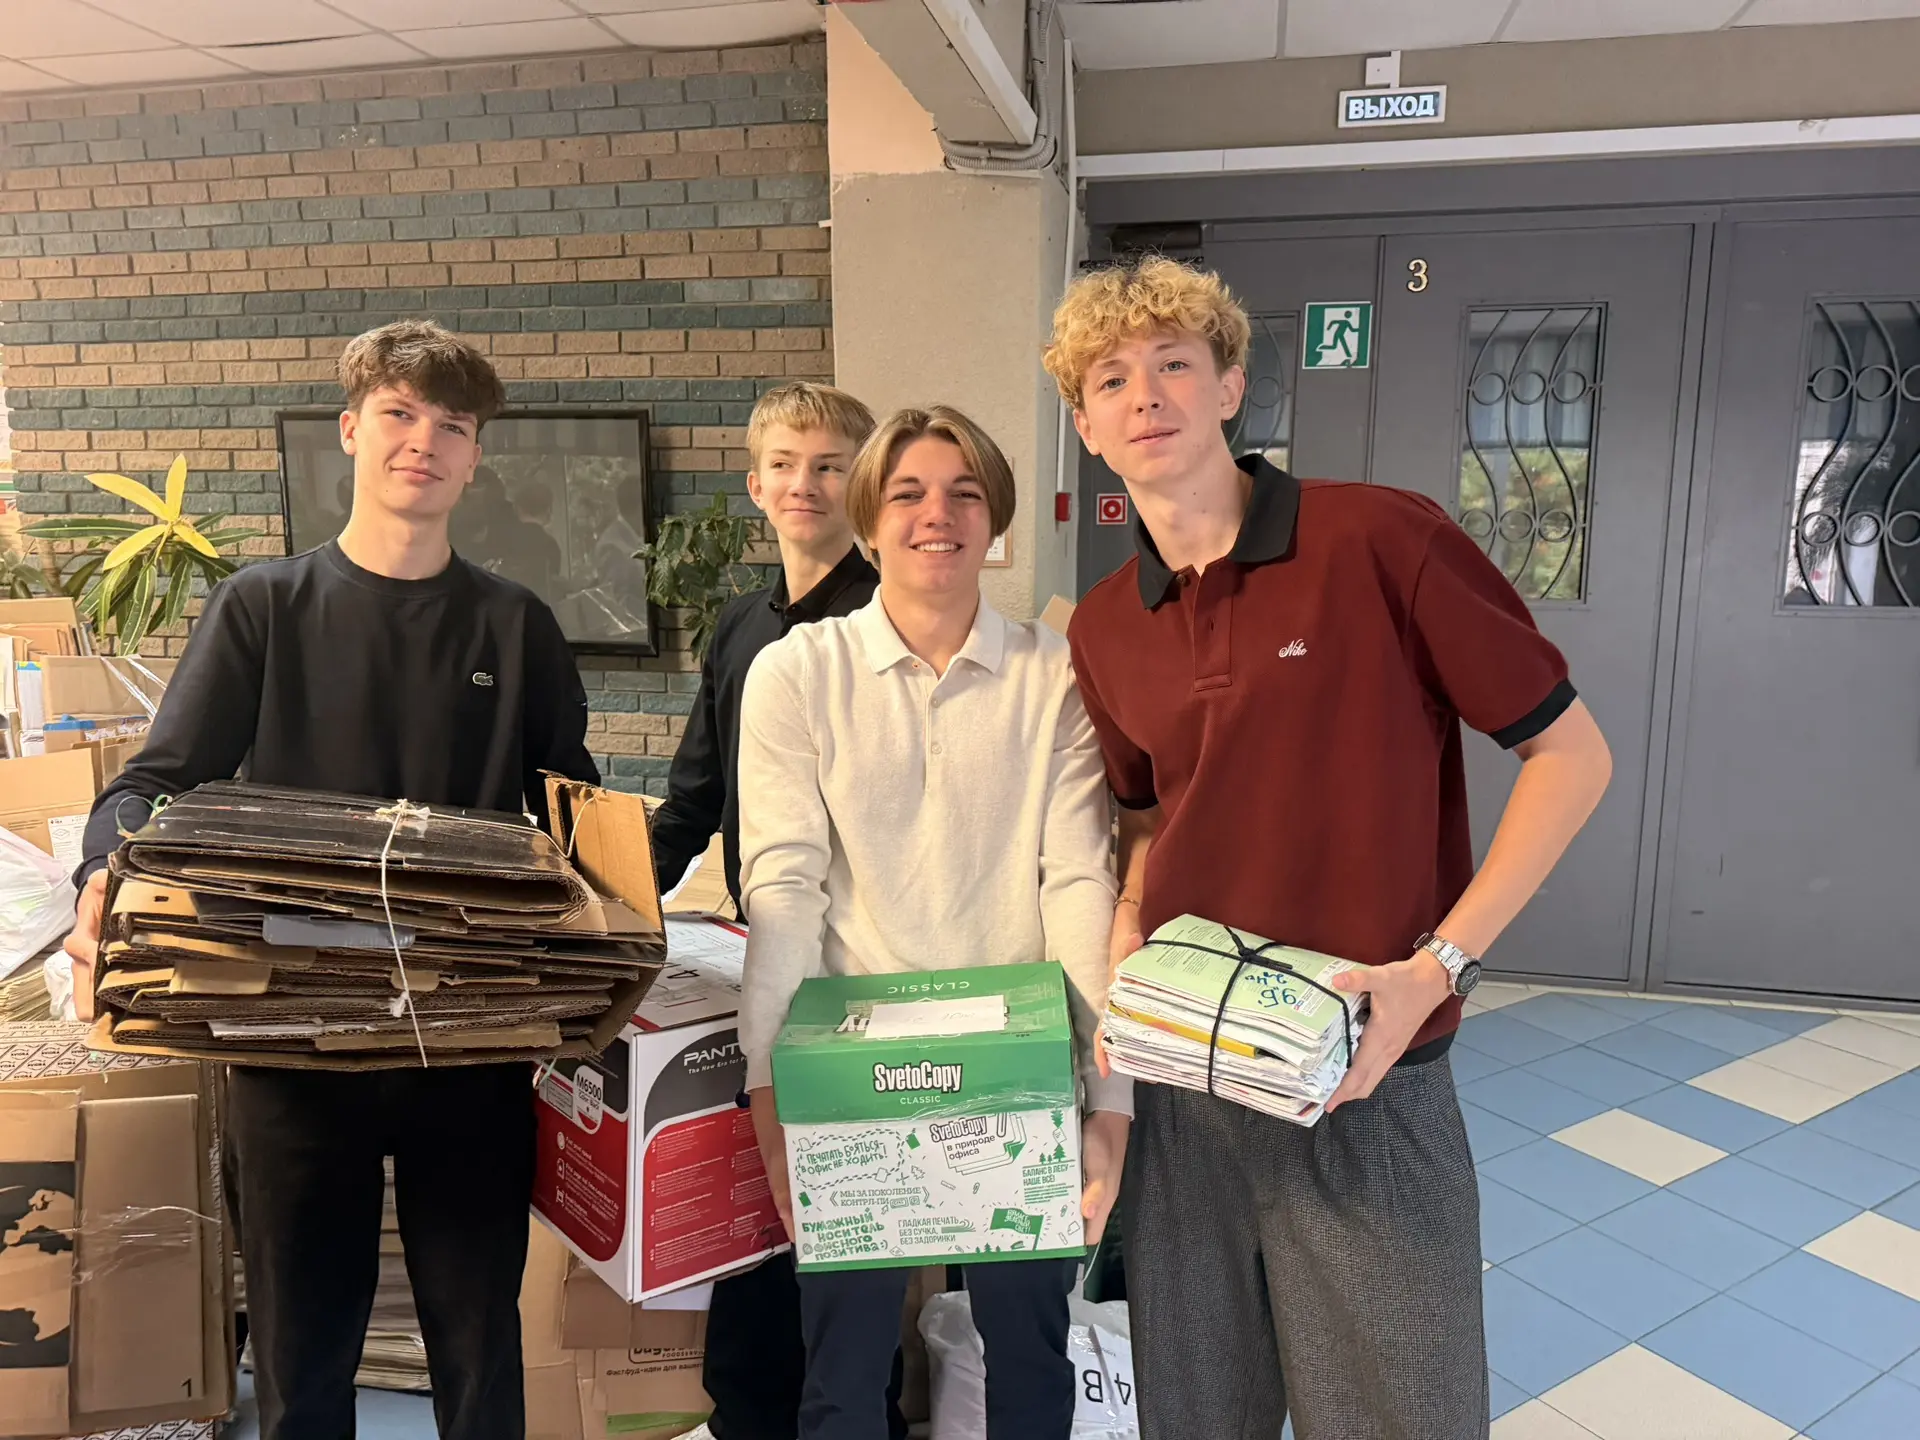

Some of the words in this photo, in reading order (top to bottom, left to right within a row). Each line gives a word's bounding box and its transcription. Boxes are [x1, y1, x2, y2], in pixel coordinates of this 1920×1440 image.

[1348, 93, 1436, 121] ВЫХОД
[1406, 258, 1429, 292] 3
[1278, 638, 1308, 658] Nike
[887, 981, 970, 994] CLASSIC
[683, 1042, 740, 1067] PANT
[701, 1064, 716, 1072] New
[873, 1060, 963, 1094] SvetoCopy
[577, 1074, 602, 1101] M6500
[899, 1095, 941, 1105] CLASSIC
[930, 1116, 987, 1143] SvetoCopy
[955, 1135, 996, 1151] природе
[806, 1148, 844, 1165] ПЕЧАТАТЬ
[949, 1147, 980, 1161] офиса
[807, 1162, 833, 1176] ОФИС
[834, 1160, 844, 1169] НЕ
[1022, 1167, 1048, 1177] БАЛАНС
[1053, 1164, 1069, 1173] ЛЕСУ
[1023, 1176, 1041, 1186] НАШЕ
[840, 1190, 857, 1198] МЫ
[868, 1187, 921, 1197] ПОКОЛЕНИЕ
[898, 1218, 931, 1228] ГЛАДКАЯ
[899, 1228, 913, 1237] БЕЗ
[900, 1236, 914, 1245] БЕЗ
[914, 1234, 956, 1245] ЗАДОРИНКИ
[181, 1378, 192, 1397] 1
[1114, 1372, 1131, 1405] 4
